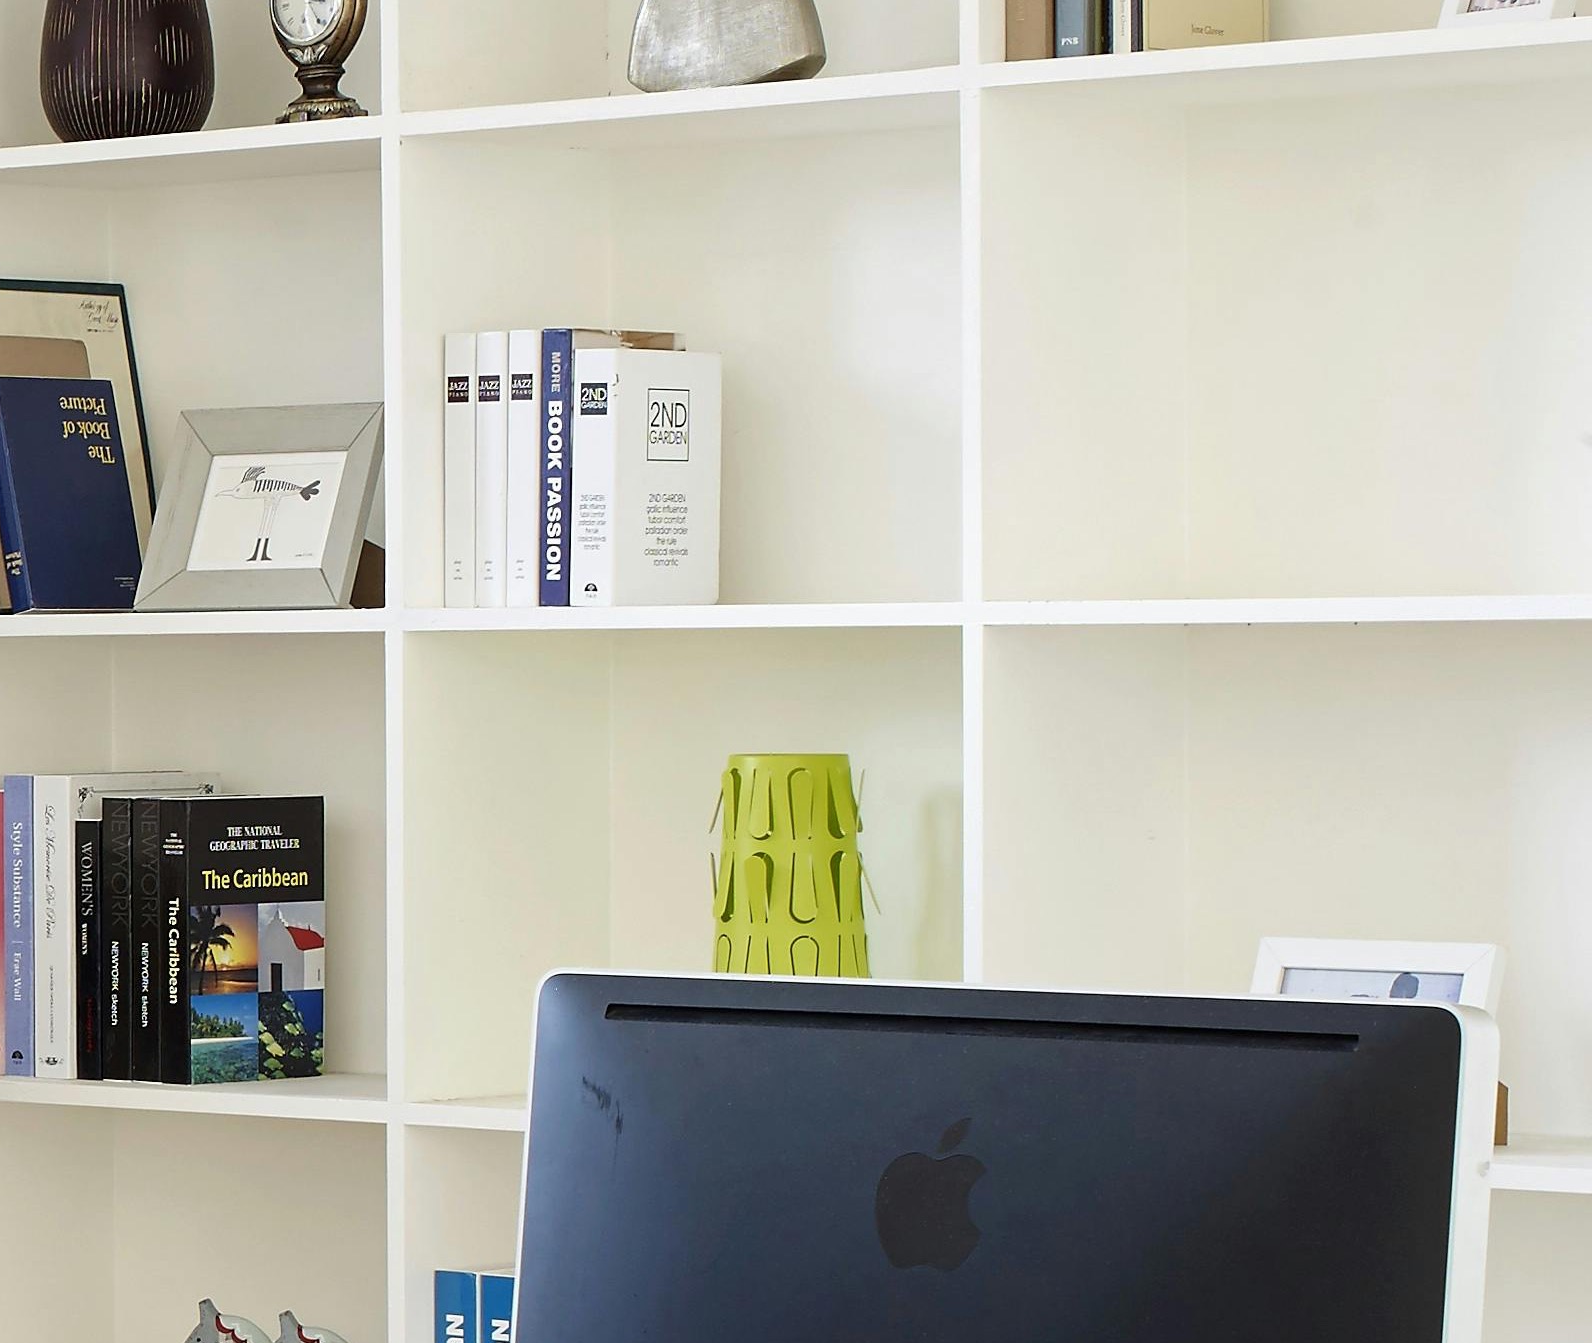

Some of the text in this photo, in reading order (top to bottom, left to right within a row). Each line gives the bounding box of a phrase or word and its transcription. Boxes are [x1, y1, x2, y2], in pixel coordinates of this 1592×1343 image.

[449, 382, 468, 391] JAZZ
[479, 381, 499, 390] JAZZ
[512, 379, 532, 389] JAZZ
[581, 387, 607, 401] 2ND
[59, 396, 108, 416] Picture
[650, 401, 688, 428] 2ND
[62, 421, 112, 440] Book of
[649, 430, 688, 445] GARDEN
[87, 445, 115, 464] The
[546, 351, 563, 581] MORE BOOK PASSION
[227, 825, 283, 837] THE NATIONAL
[209, 838, 300, 852] GEOGRAPHIC TRAVELER
[11, 821, 24, 929] Style Substance
[80, 841, 94, 917] WOMEN'S
[201, 867, 309, 890] The Caribbean
[169, 897, 180, 1005] The Caribbean
[13, 975, 22, 1001] Wall
